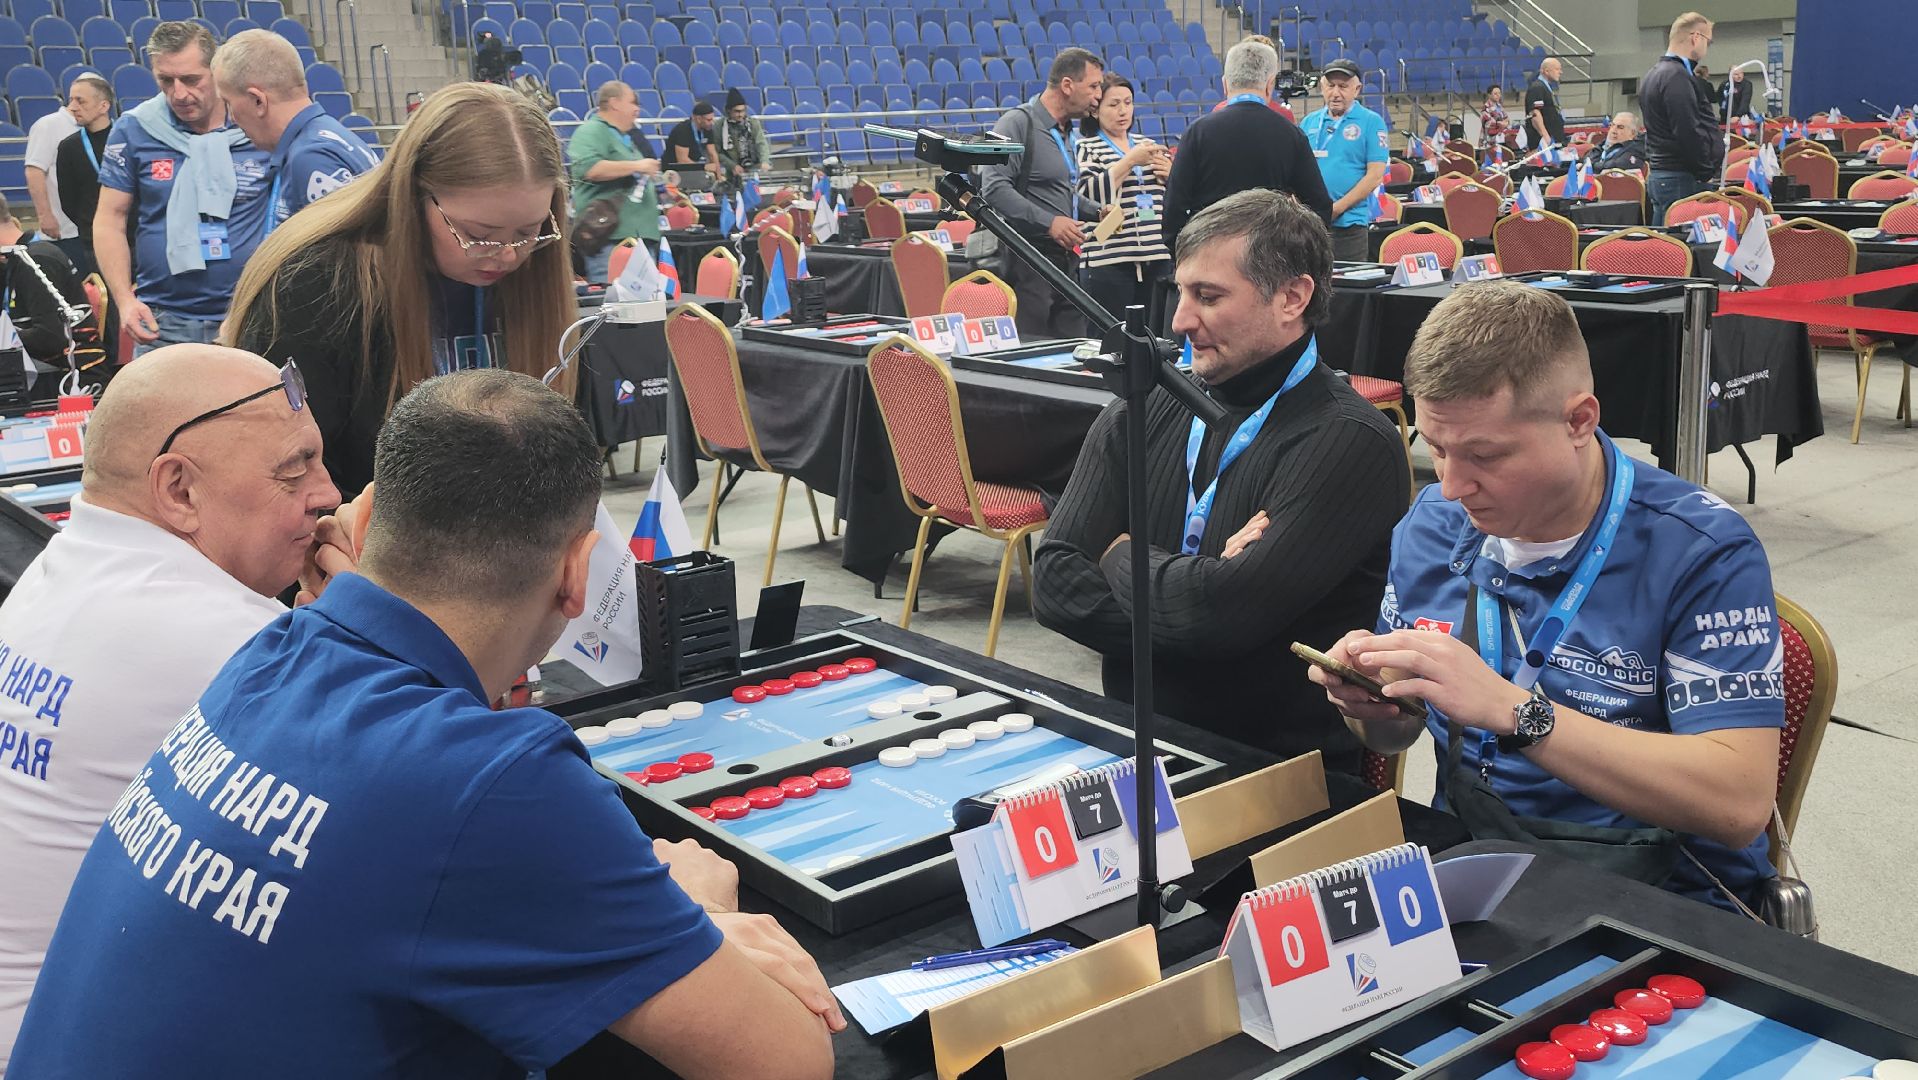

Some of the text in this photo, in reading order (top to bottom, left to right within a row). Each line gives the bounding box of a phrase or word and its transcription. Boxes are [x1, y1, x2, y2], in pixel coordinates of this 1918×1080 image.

[921, 326, 929, 339] 0
[970, 329, 978, 342] 0
[1003, 326, 1011, 337] 0
[58, 438, 71, 454] 0
[593, 566, 625, 623] ФЕДЕРАЦИЯ
[602, 591, 627, 631] РОССИИ
[1694, 605, 1772, 631] НАРДЫ
[1613, 668, 1654, 683] ФНС
[0, 654, 74, 727] НАРД
[1565, 688, 1628, 707] ФЕДЕРАЦИЯ
[1580, 704, 1608, 719] НАРД
[1610, 716, 1643, 728] БУРГА
[209, 761, 330, 869] НАРД
[1089, 802, 1102, 824] 7
[107, 767, 290, 945] ЙСКОГО КРАЯ
[1034, 826, 1057, 863] 0
[1343, 900, 1357, 925] 7
[1398, 885, 1422, 928] 0
[1281, 925, 1305, 969] 0
